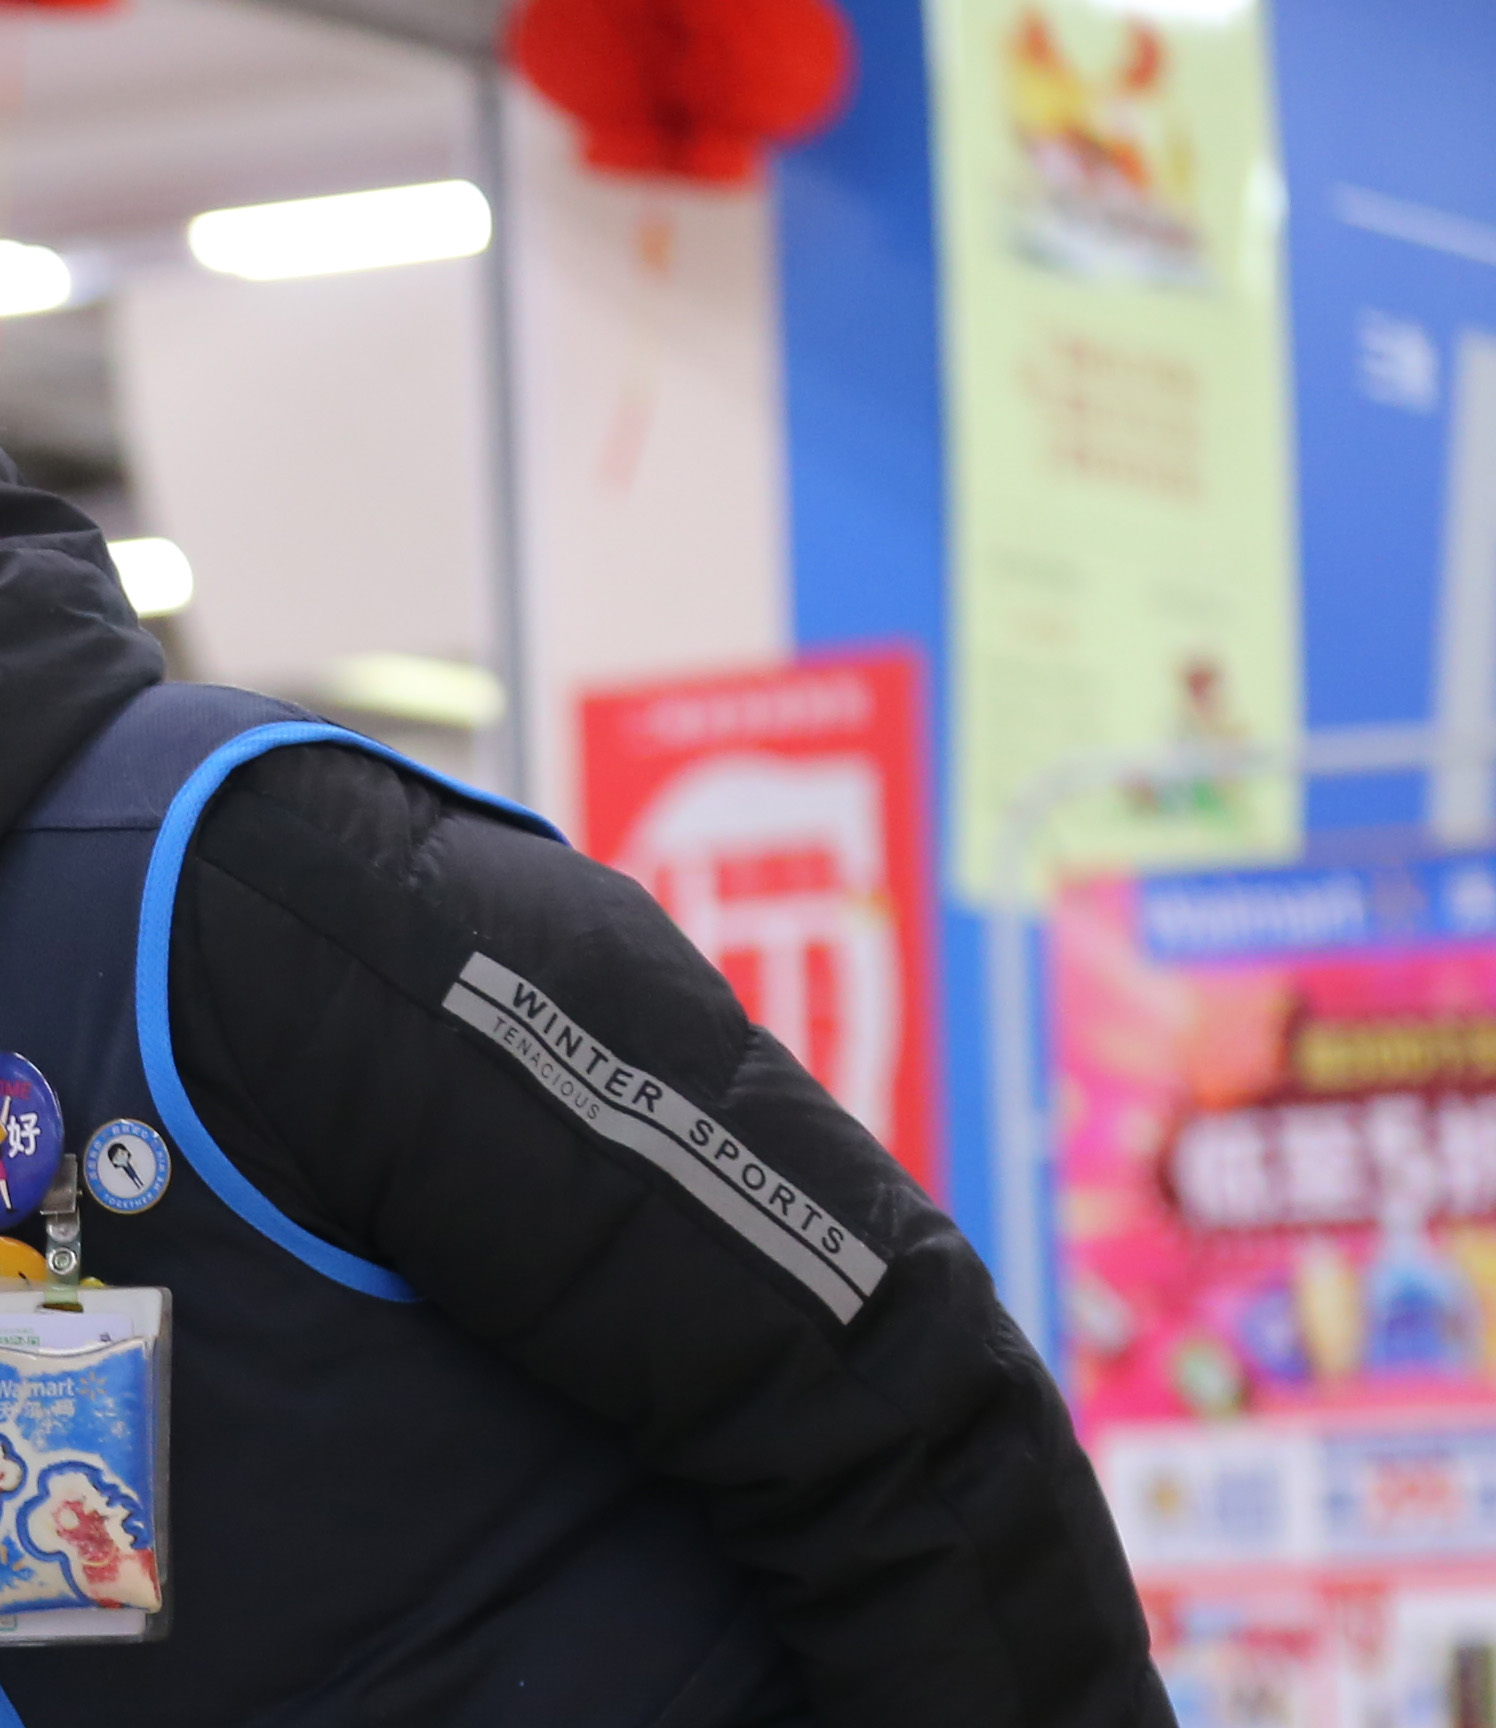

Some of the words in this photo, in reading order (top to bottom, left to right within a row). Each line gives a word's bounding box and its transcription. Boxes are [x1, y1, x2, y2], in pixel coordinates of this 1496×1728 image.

[492, 1015, 601, 1121] TENACIOUS
[512, 981, 664, 1114] WINTER
[688, 1118, 846, 1255] SPORTS
